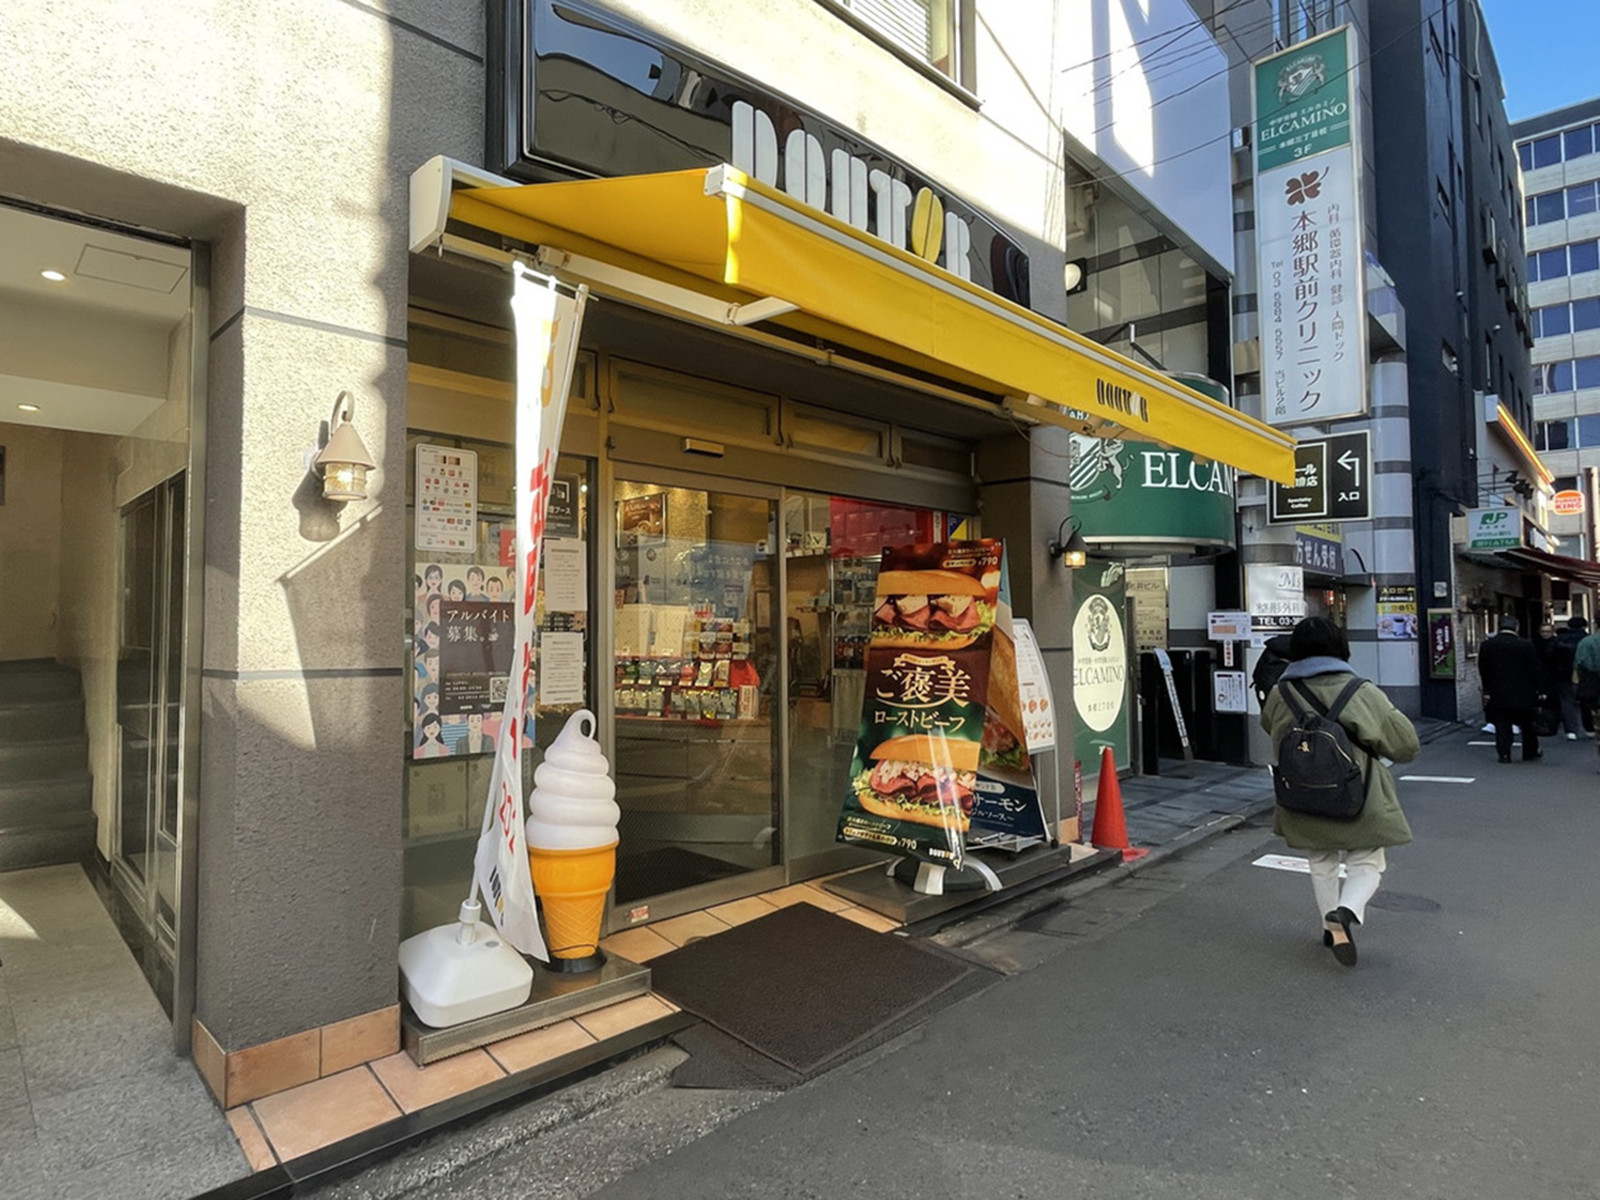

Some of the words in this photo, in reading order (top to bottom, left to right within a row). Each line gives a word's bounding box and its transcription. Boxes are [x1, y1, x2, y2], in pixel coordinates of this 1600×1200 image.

[1261, 102, 1347, 141] ELCAMINO
[1294, 143, 1312, 157] 3F
[732, 100, 971, 282] DOUTOR
[1291, 210, 1322, 412] 本郷駅前クリニック
[1097, 378, 1149, 422] DOUTOR
[1338, 491, 1360, 502] 入口
[447, 609, 510, 623] アルバイト
[1258, 617, 1277, 625] TEL
[447, 625, 485, 642] 募集。
[876, 666, 972, 708] ご褒美
[1073, 666, 1124, 687] ELCAMINO
[874, 709, 966, 733] ローストビーフ
